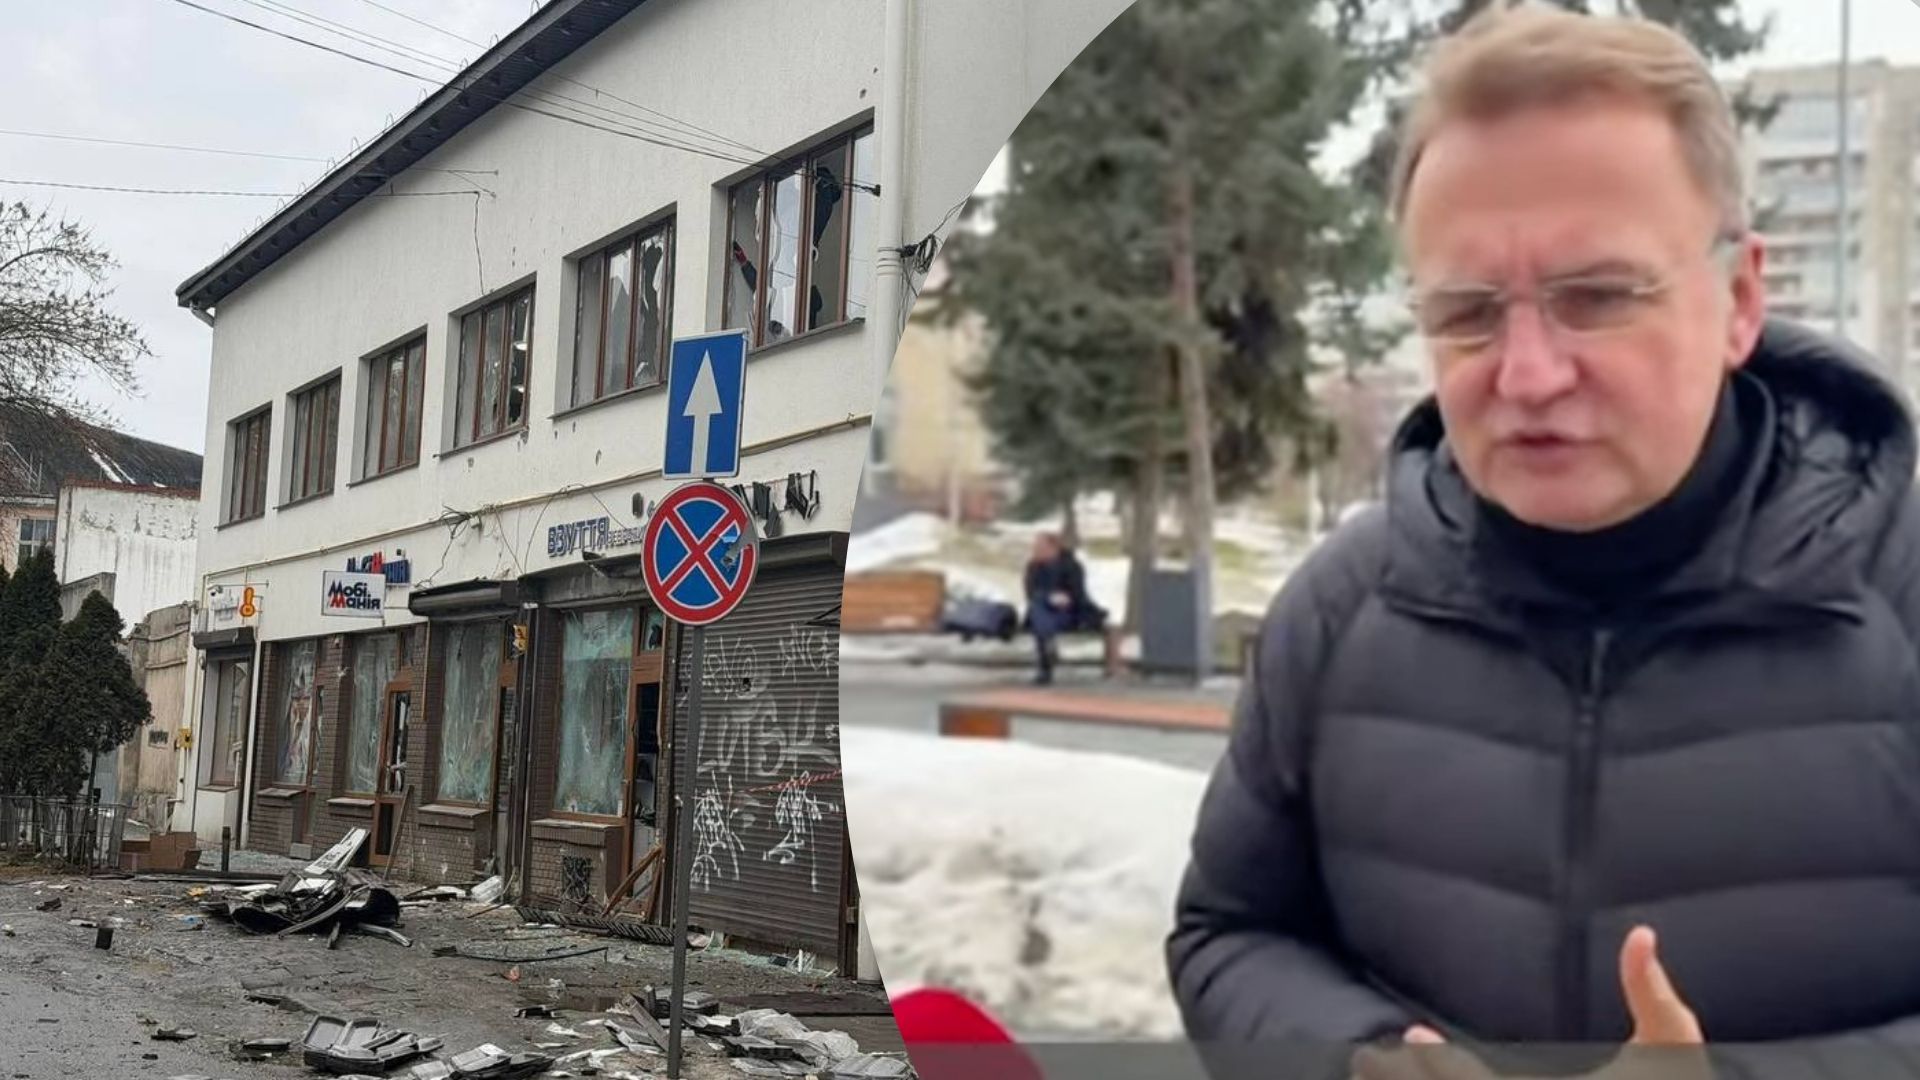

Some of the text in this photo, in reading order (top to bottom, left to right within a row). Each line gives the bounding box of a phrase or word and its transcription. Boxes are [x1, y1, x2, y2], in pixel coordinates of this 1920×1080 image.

[547, 515, 610, 557] ВЗУТТЯ
[328, 580, 367, 598] Мобі
[330, 593, 381, 609] Манія
